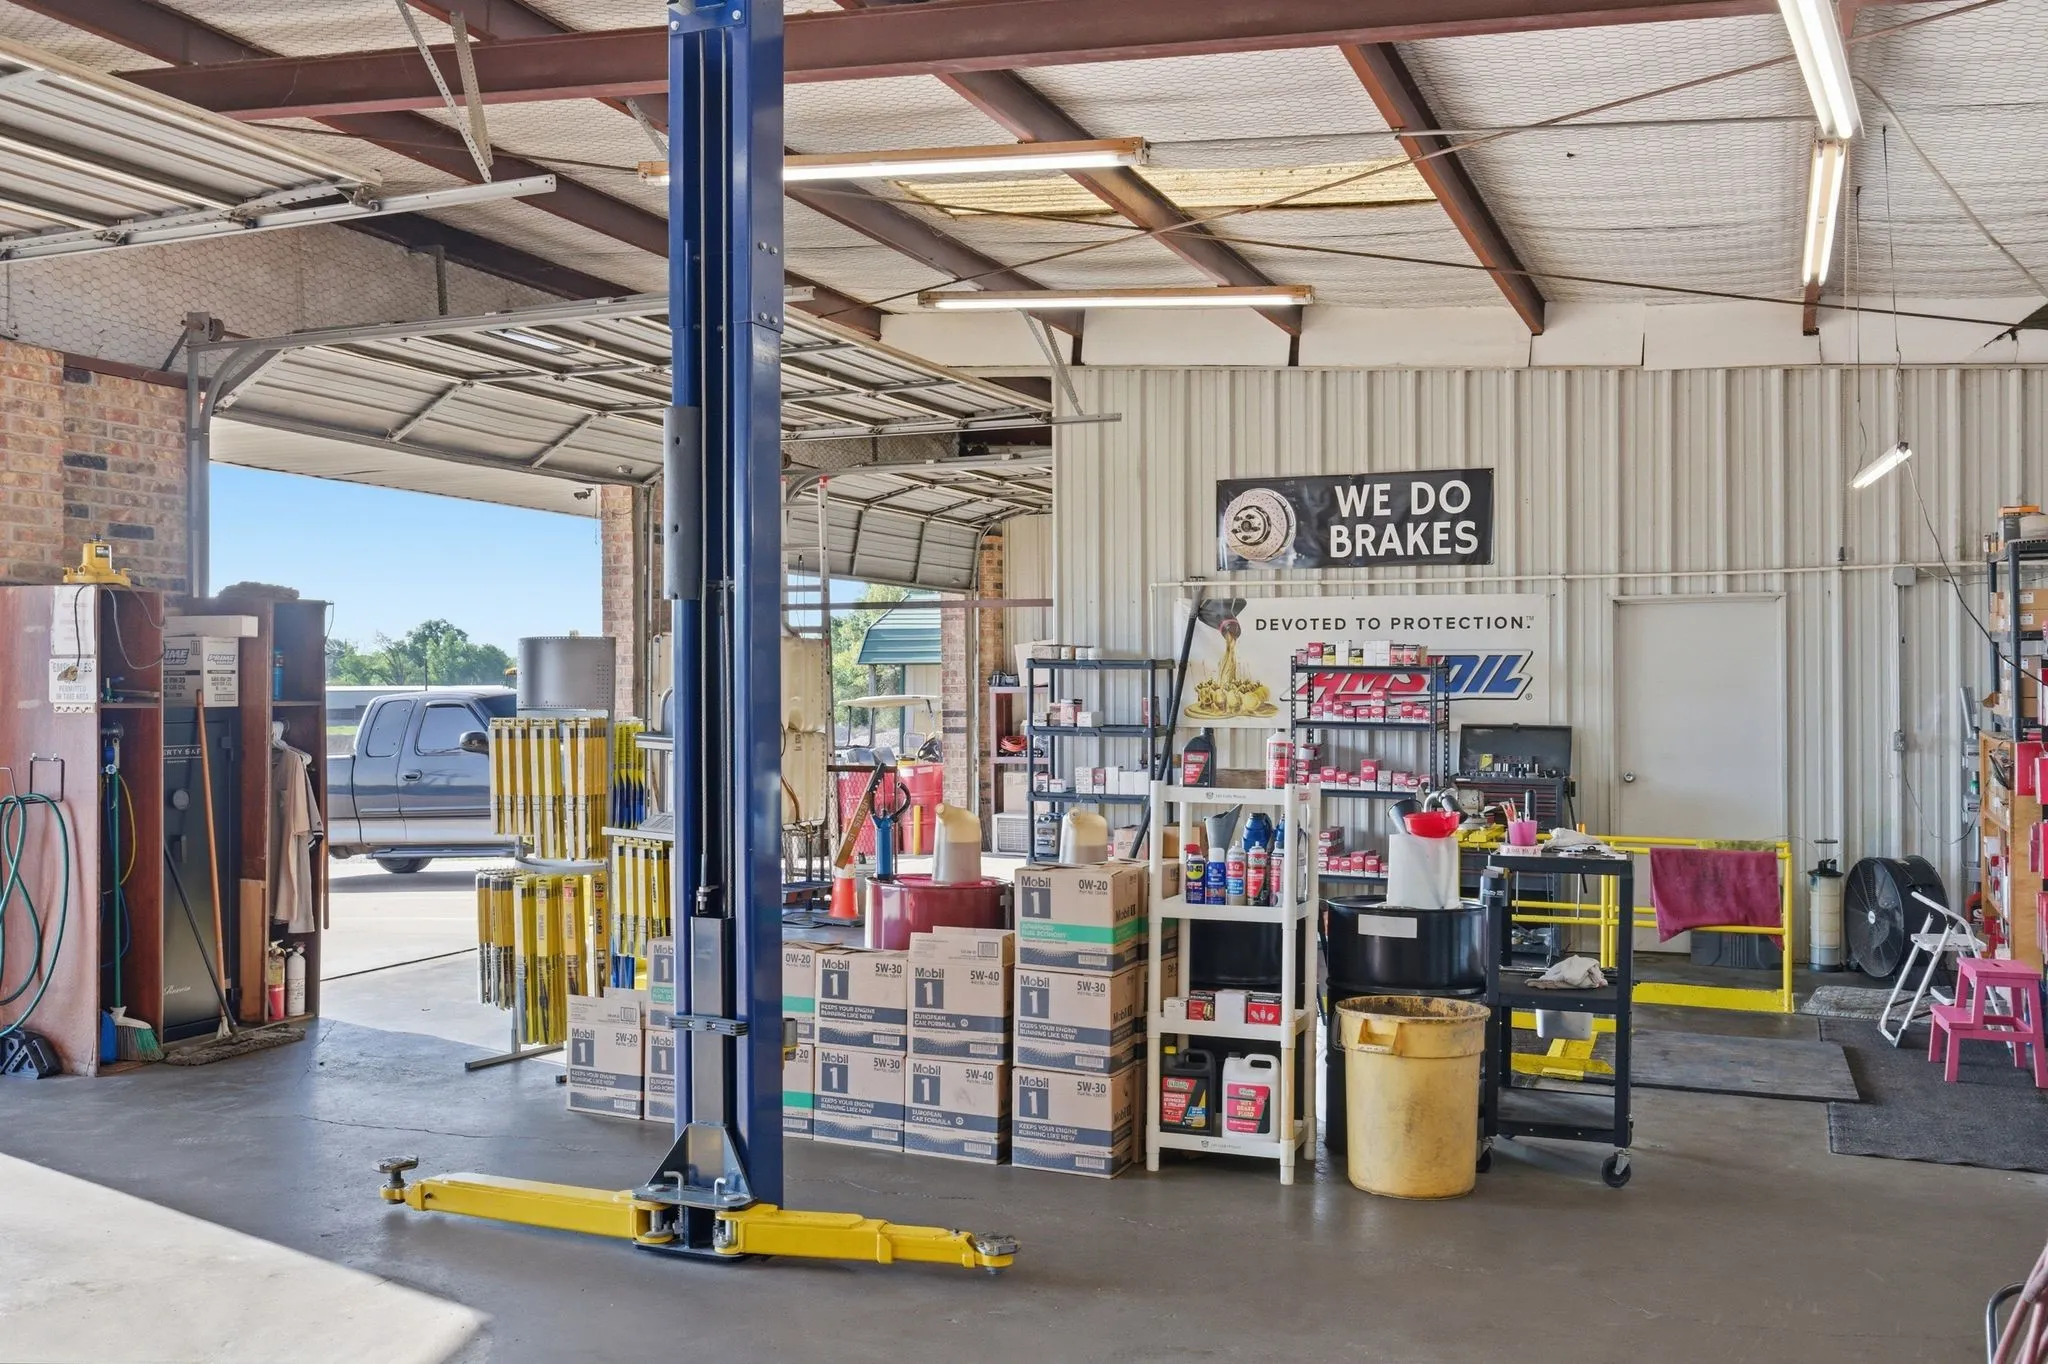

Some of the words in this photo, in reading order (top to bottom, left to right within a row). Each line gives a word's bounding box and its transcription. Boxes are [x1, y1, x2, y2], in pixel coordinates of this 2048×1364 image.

[1334, 483, 1391, 518] WE
[1410, 479, 1471, 516] DO
[1330, 520, 1479, 558] BRAKES
[1256, 618, 1346, 631] DEVOTED
[1356, 618, 1381, 630] TO
[1021, 875, 1051, 887] Mobil
[1079, 879, 1108, 890] 0W-20
[1030, 891, 1040, 914] 1
[653, 944, 674, 955] Mob
[785, 953, 811, 964] 0W-20
[822, 959, 850, 970] Mobil
[660, 957, 669, 980] 1
[875, 963, 902, 974] 5W-30
[915, 967, 944, 979] Mobil
[970, 970, 1000, 981] 5W-40
[1020, 975, 1049, 988] Mobil
[830, 973, 838, 996] 1
[1077, 980, 1106, 993] 5W-30
[923, 981, 933, 1005] 1
[1029, 990, 1038, 1014] 1
[571, 1028, 595, 1040] Mobil
[615, 1032, 638, 1043] 5W-20
[651, 1035, 674, 1047] Mobi
[579, 1042, 586, 1063] 1
[796, 1049, 808, 1059] -20
[822, 1052, 848, 1064] Mobil
[659, 1049, 667, 1071] 1
[873, 1057, 900, 1069] 5W-30
[913, 1063, 941, 1075] Mobil
[965, 1068, 994, 1080] 5W-40
[830, 1067, 838, 1089] 1
[1019, 1075, 1049, 1088] Mobil
[921, 1078, 930, 1101] 1
[1077, 1081, 1107, 1094] 5W-30
[1028, 1091, 1038, 1114] 1
